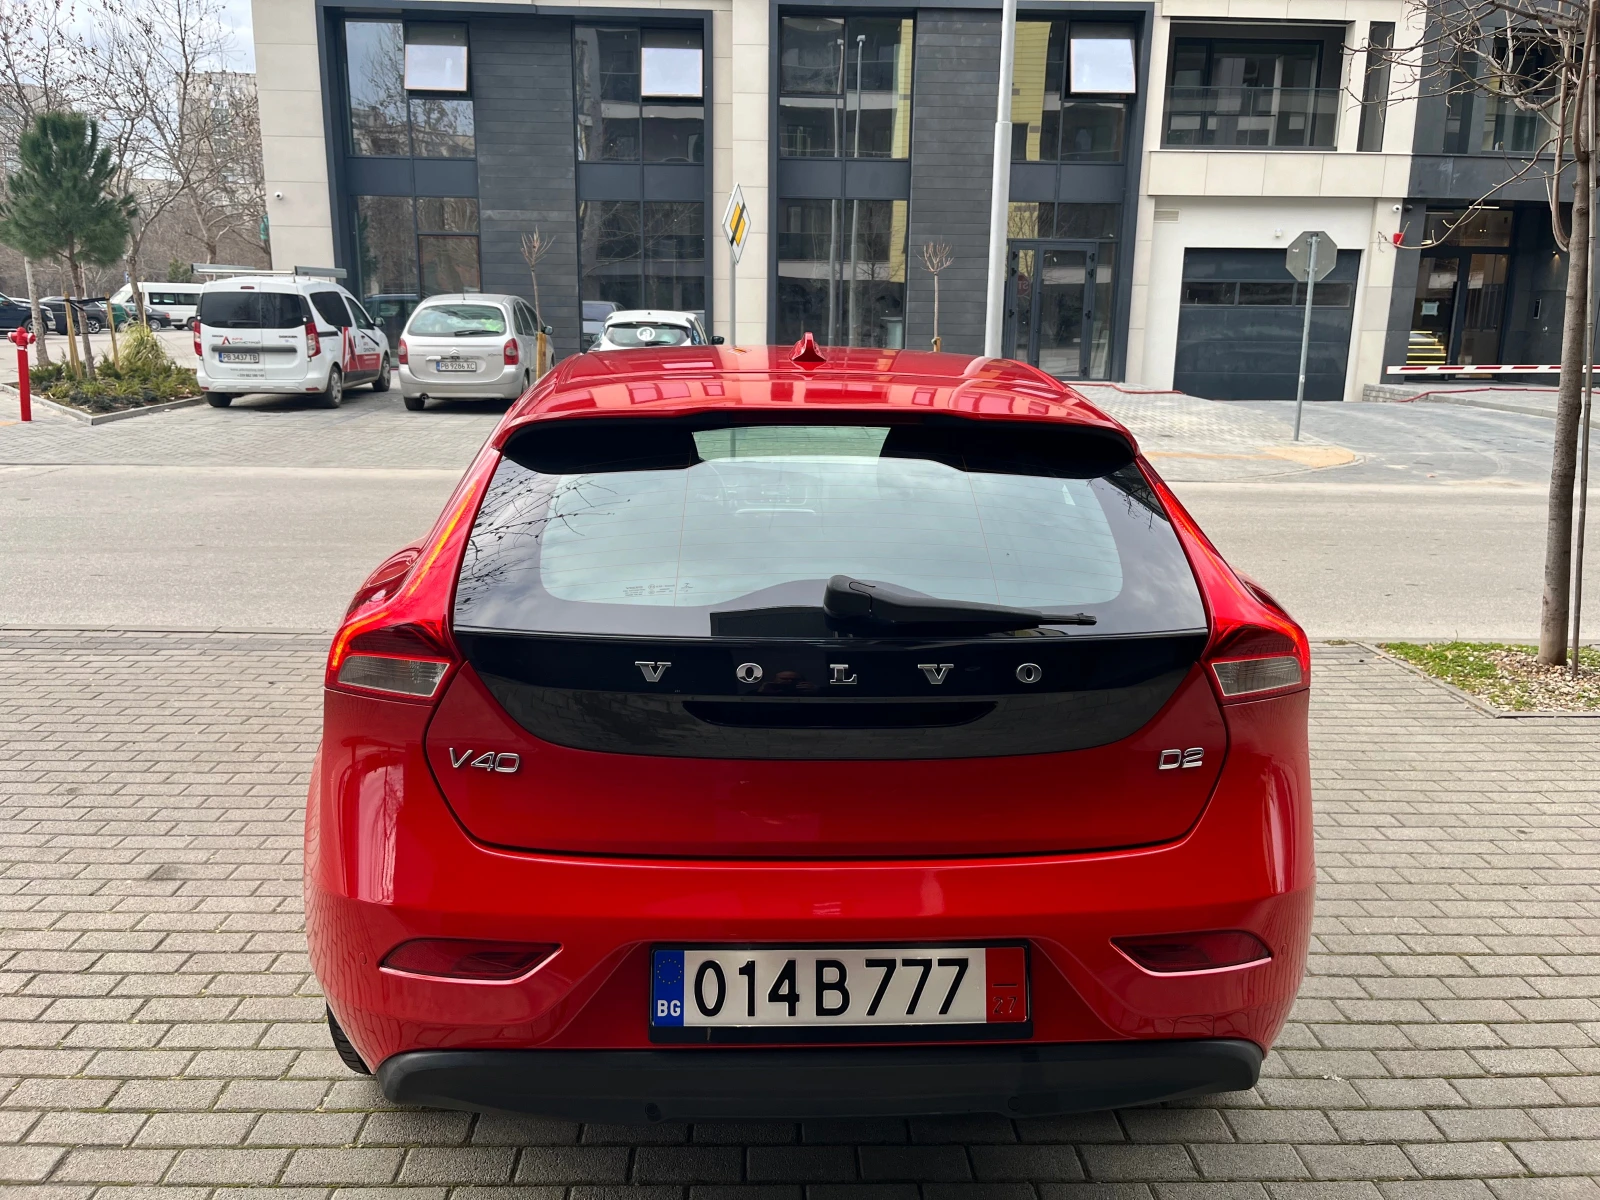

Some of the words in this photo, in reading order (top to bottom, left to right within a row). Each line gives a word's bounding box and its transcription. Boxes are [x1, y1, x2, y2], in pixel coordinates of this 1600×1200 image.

[450, 362, 465, 370] 9286
[635, 661, 1042, 685] VOLVO
[449, 747, 519, 773] V40
[1159, 747, 1204, 770] D2
[657, 1000, 681, 1017] BG
